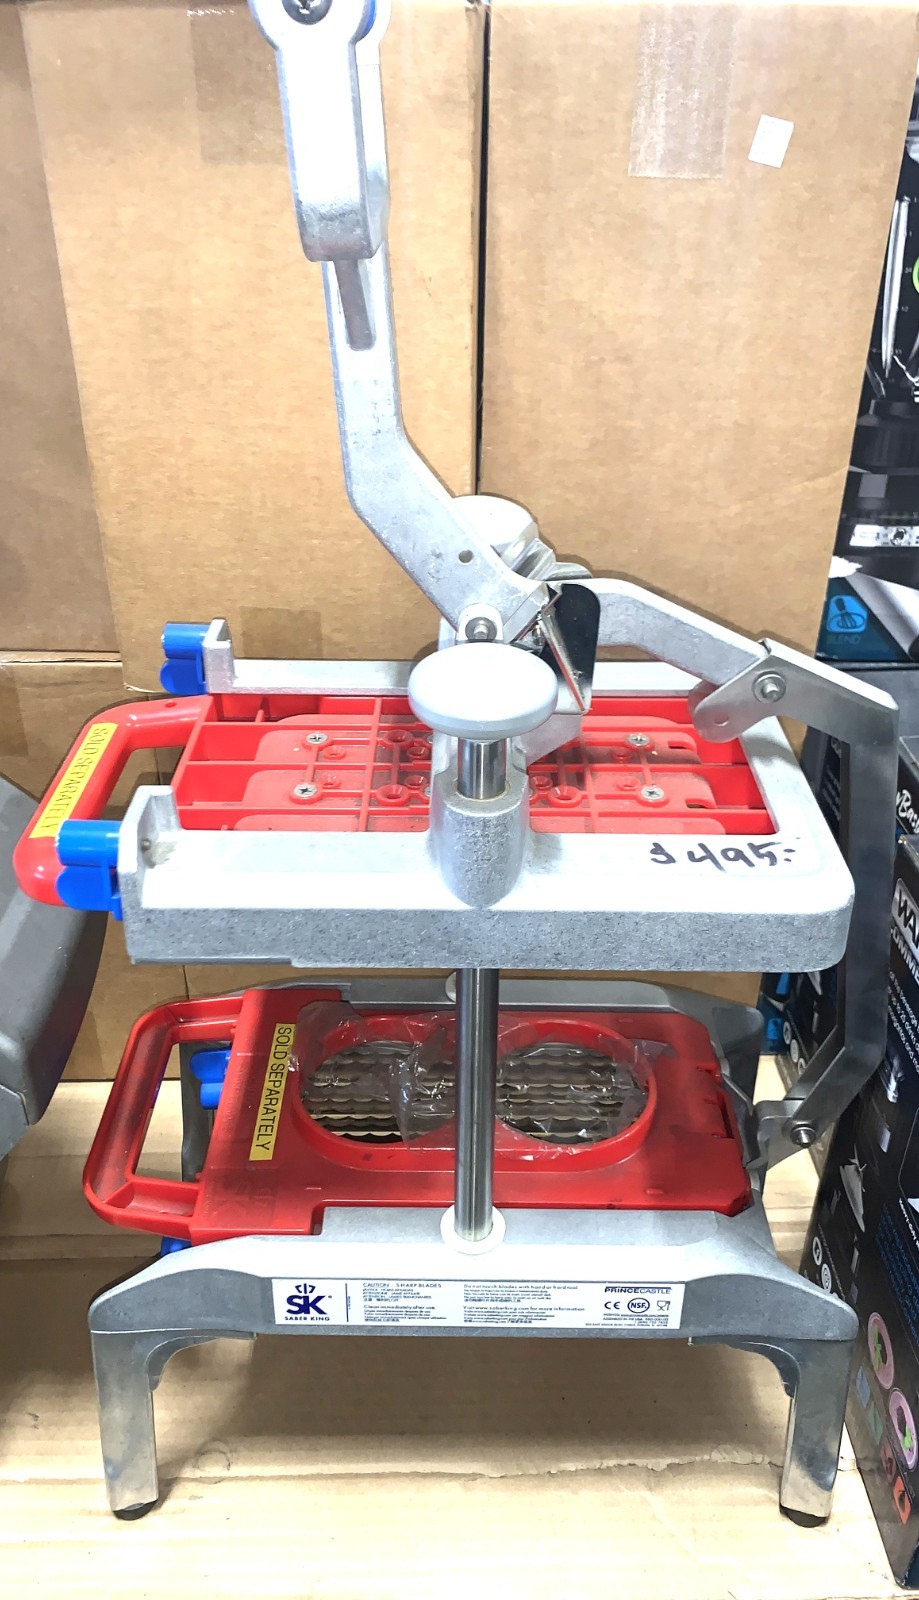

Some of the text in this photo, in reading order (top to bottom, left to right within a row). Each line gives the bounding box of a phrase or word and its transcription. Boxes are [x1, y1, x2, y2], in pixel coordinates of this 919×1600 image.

[41, 728, 109, 832] SOLD SEPARATELY
[255, 1026, 292, 1151] SOLD SEPARATELY
[604, 1301, 621, 1310] CE
